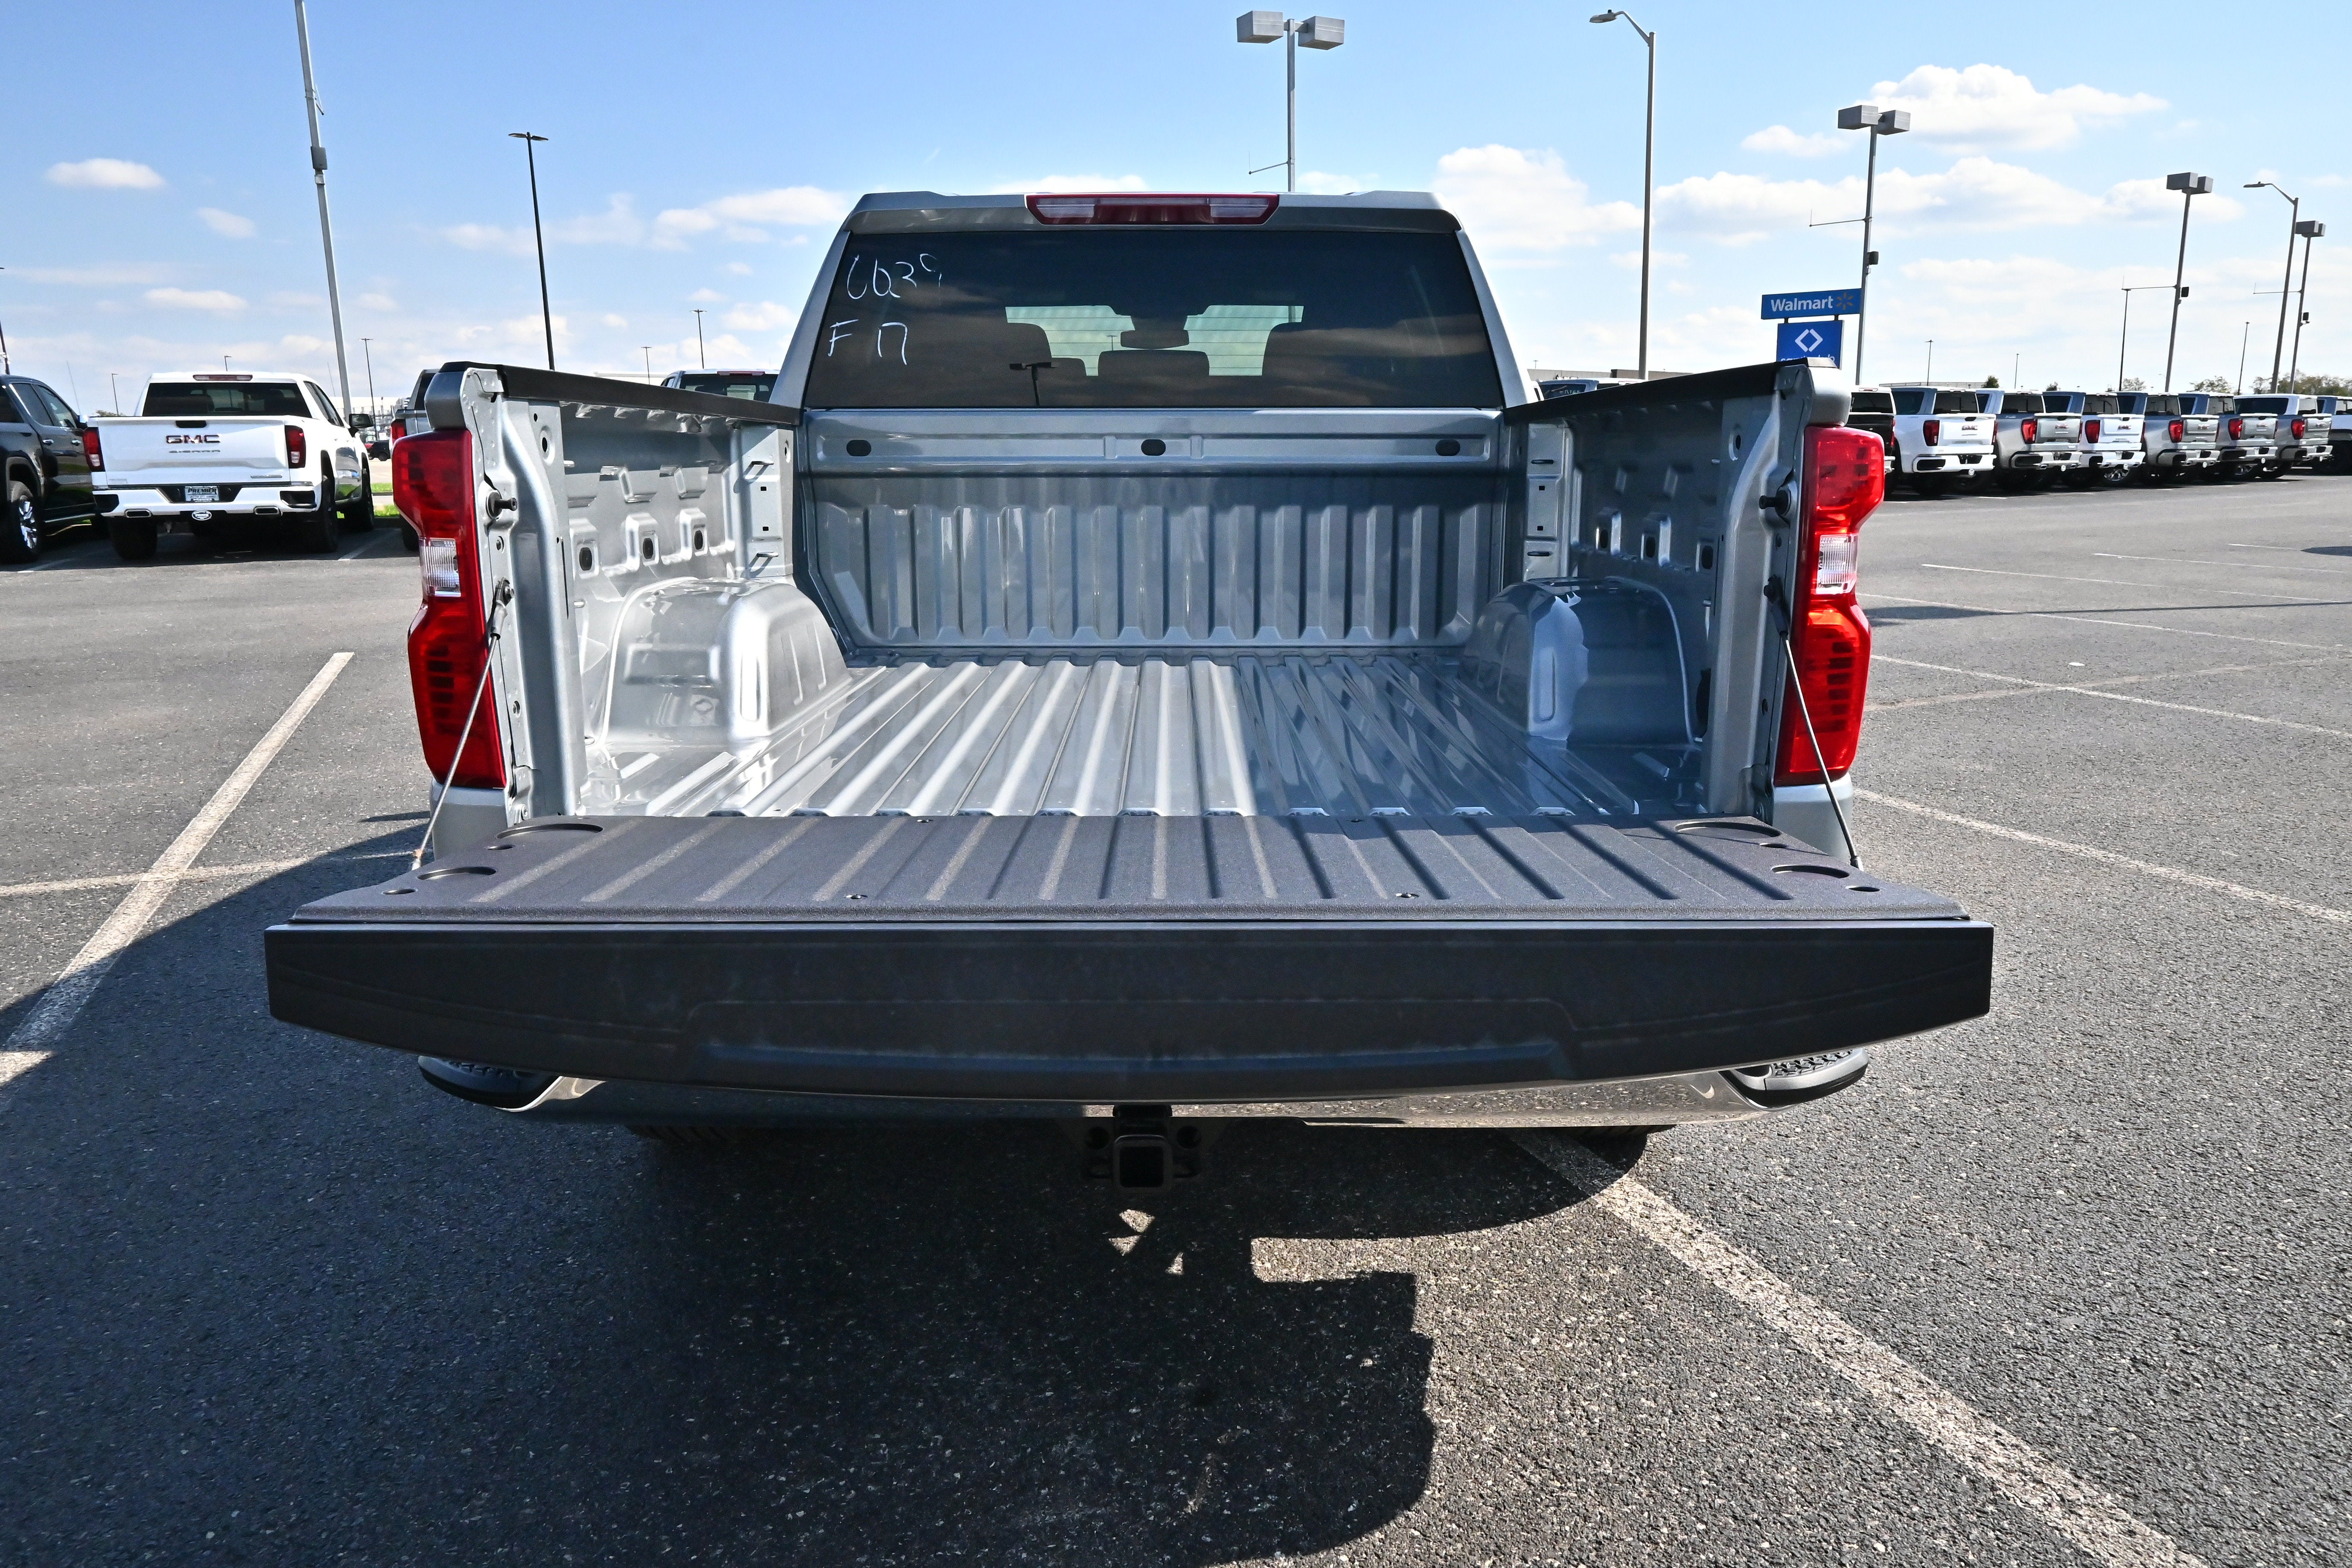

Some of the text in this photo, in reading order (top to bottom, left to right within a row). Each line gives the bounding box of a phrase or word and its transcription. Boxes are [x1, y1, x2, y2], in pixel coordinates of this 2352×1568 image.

[1770, 296, 1833, 312] Walmart
[827, 319, 859, 357] F
[166, 435, 220, 444] GMC
